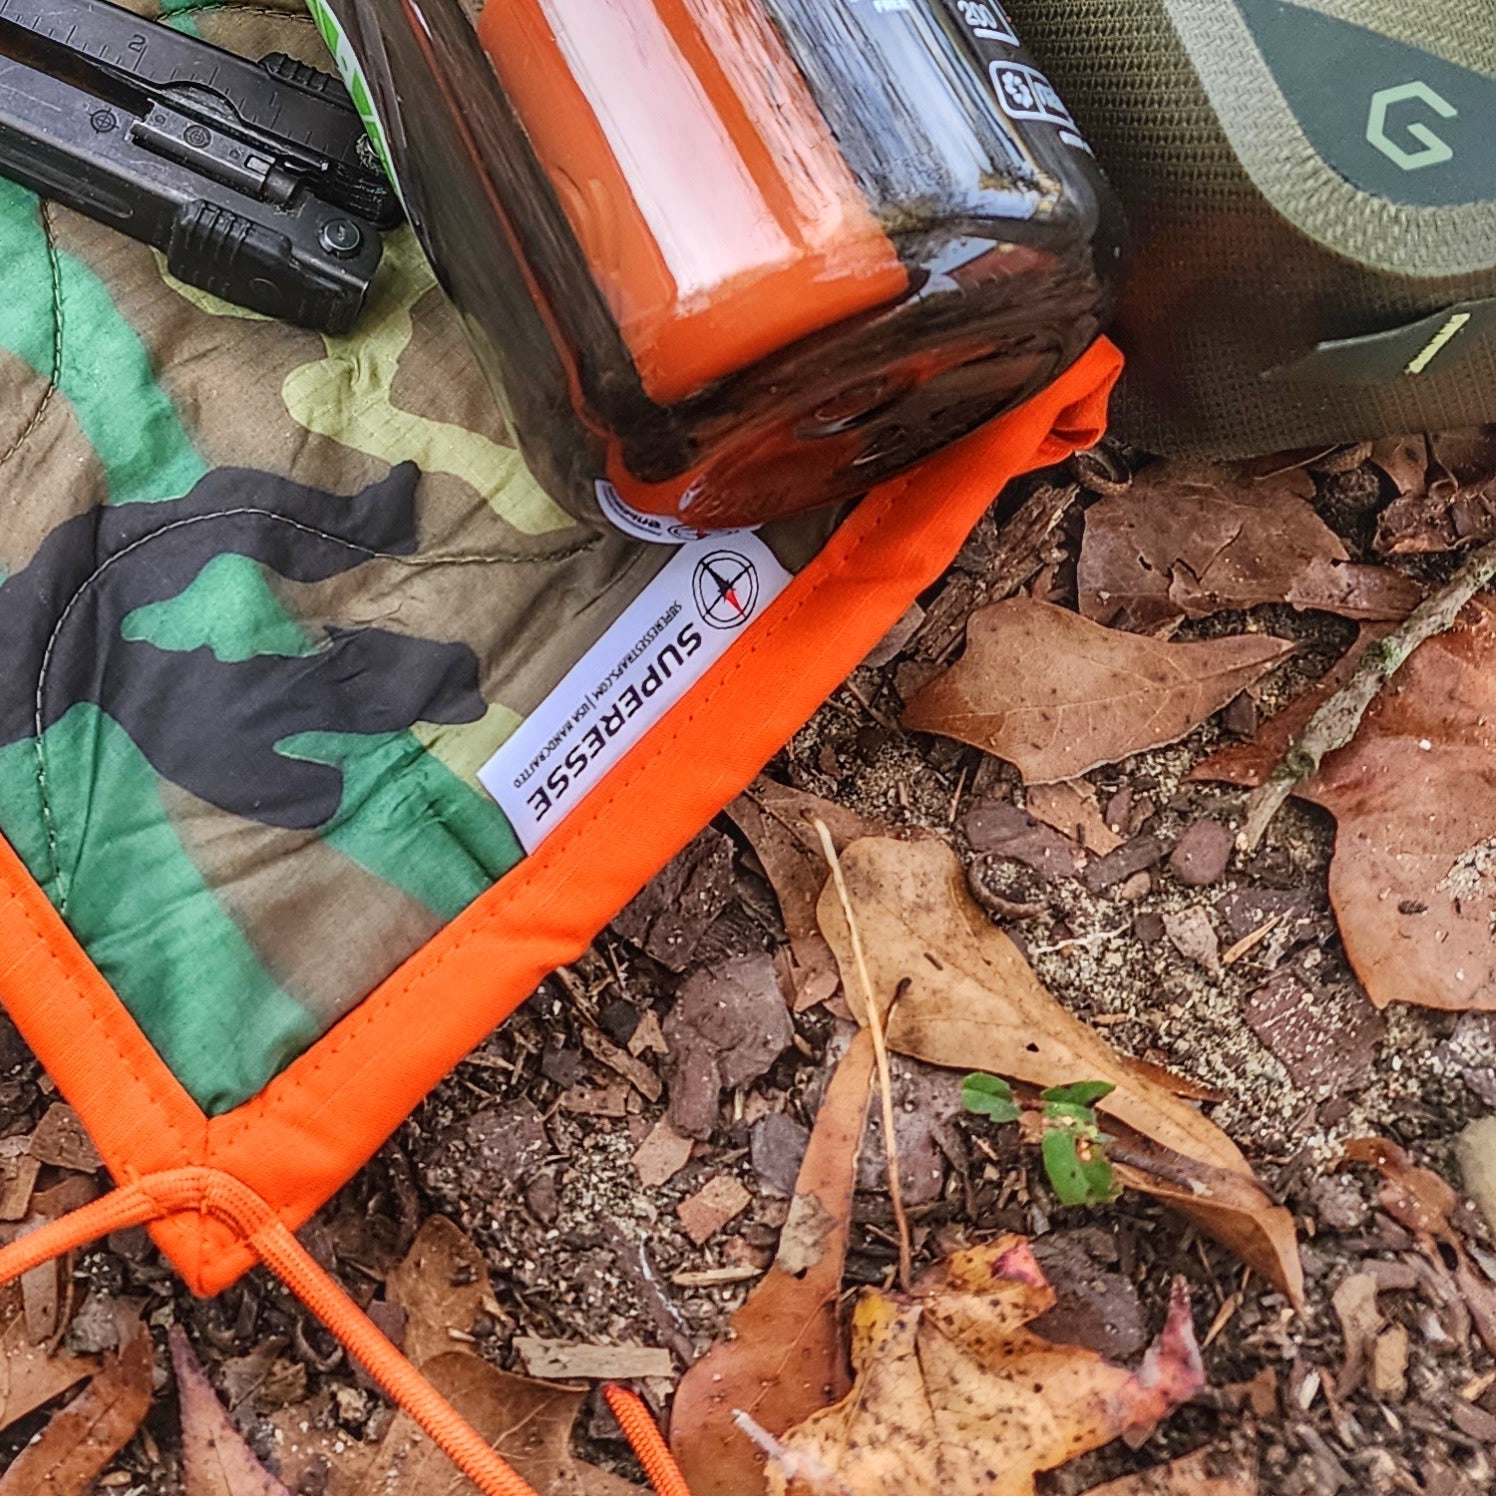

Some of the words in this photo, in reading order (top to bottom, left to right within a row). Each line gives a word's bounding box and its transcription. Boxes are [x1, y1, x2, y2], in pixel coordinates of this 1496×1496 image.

[956, 0, 998, 30] 200
[128, 34, 147, 53] 2
[525, 621, 709, 822] SUPERESSE
[569, 702, 592, 723] USA
